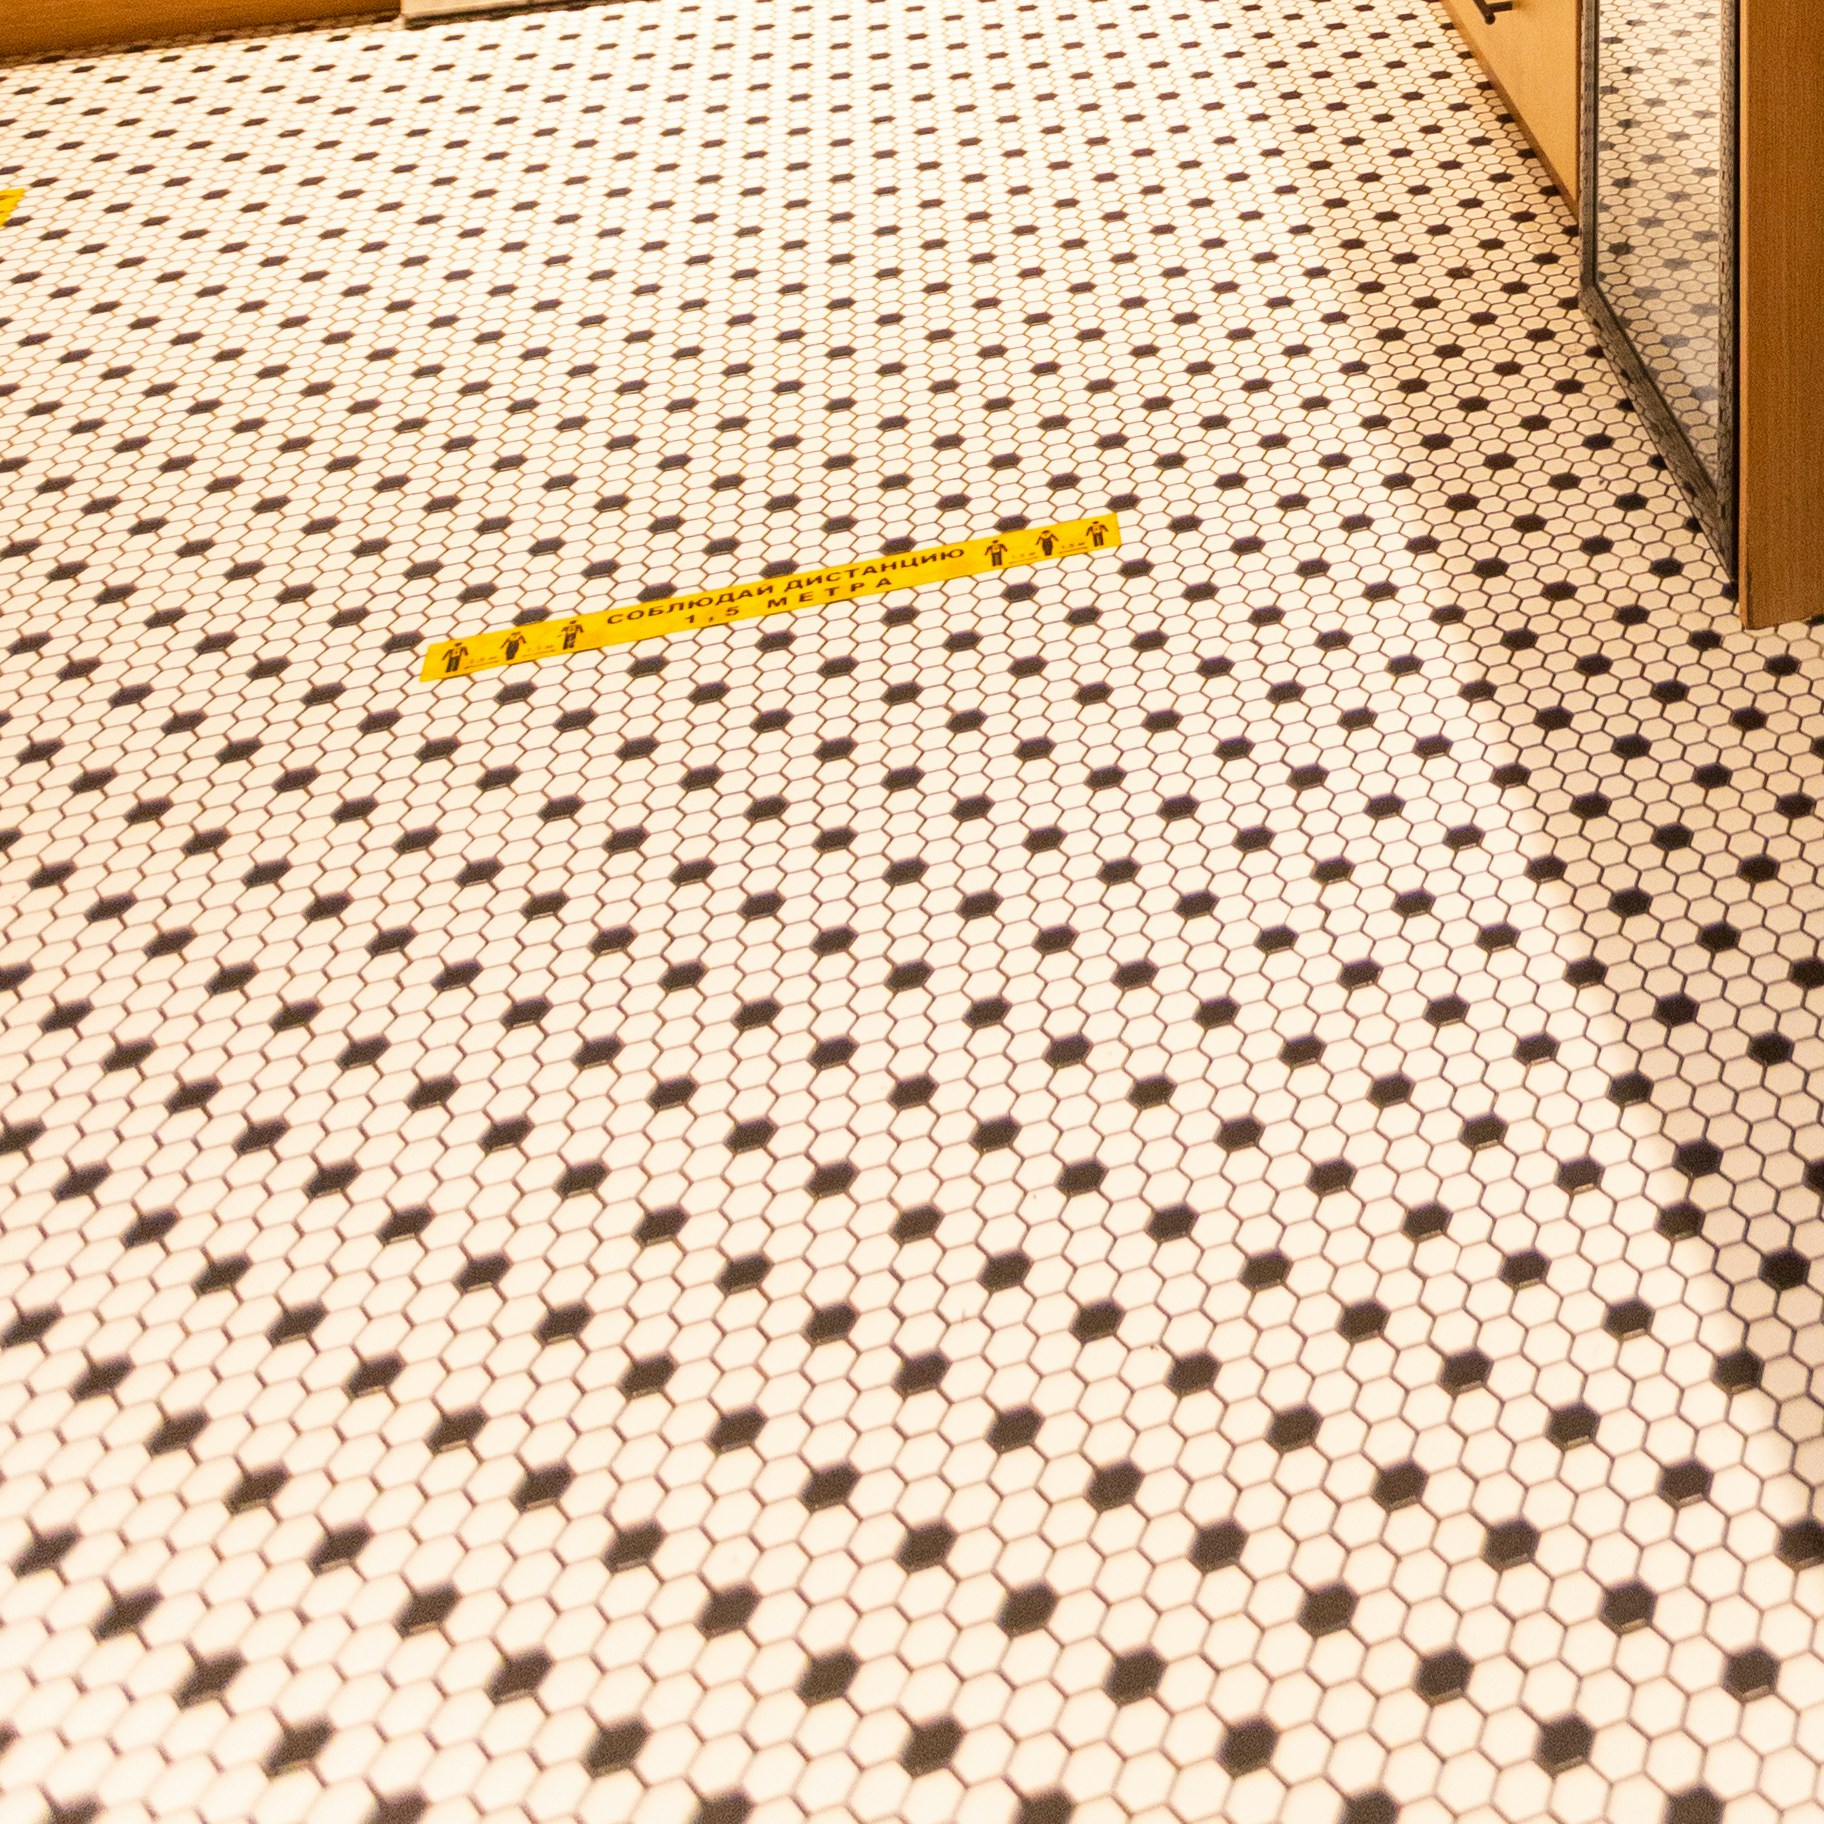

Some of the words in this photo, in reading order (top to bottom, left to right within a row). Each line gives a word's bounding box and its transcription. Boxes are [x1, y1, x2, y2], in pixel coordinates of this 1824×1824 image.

[607, 584, 774, 625] СОБЛЮДАЙ
[783, 548, 965, 592] ДИСТАНЦИЮ
[767, 577, 893, 609] МЕТРА
